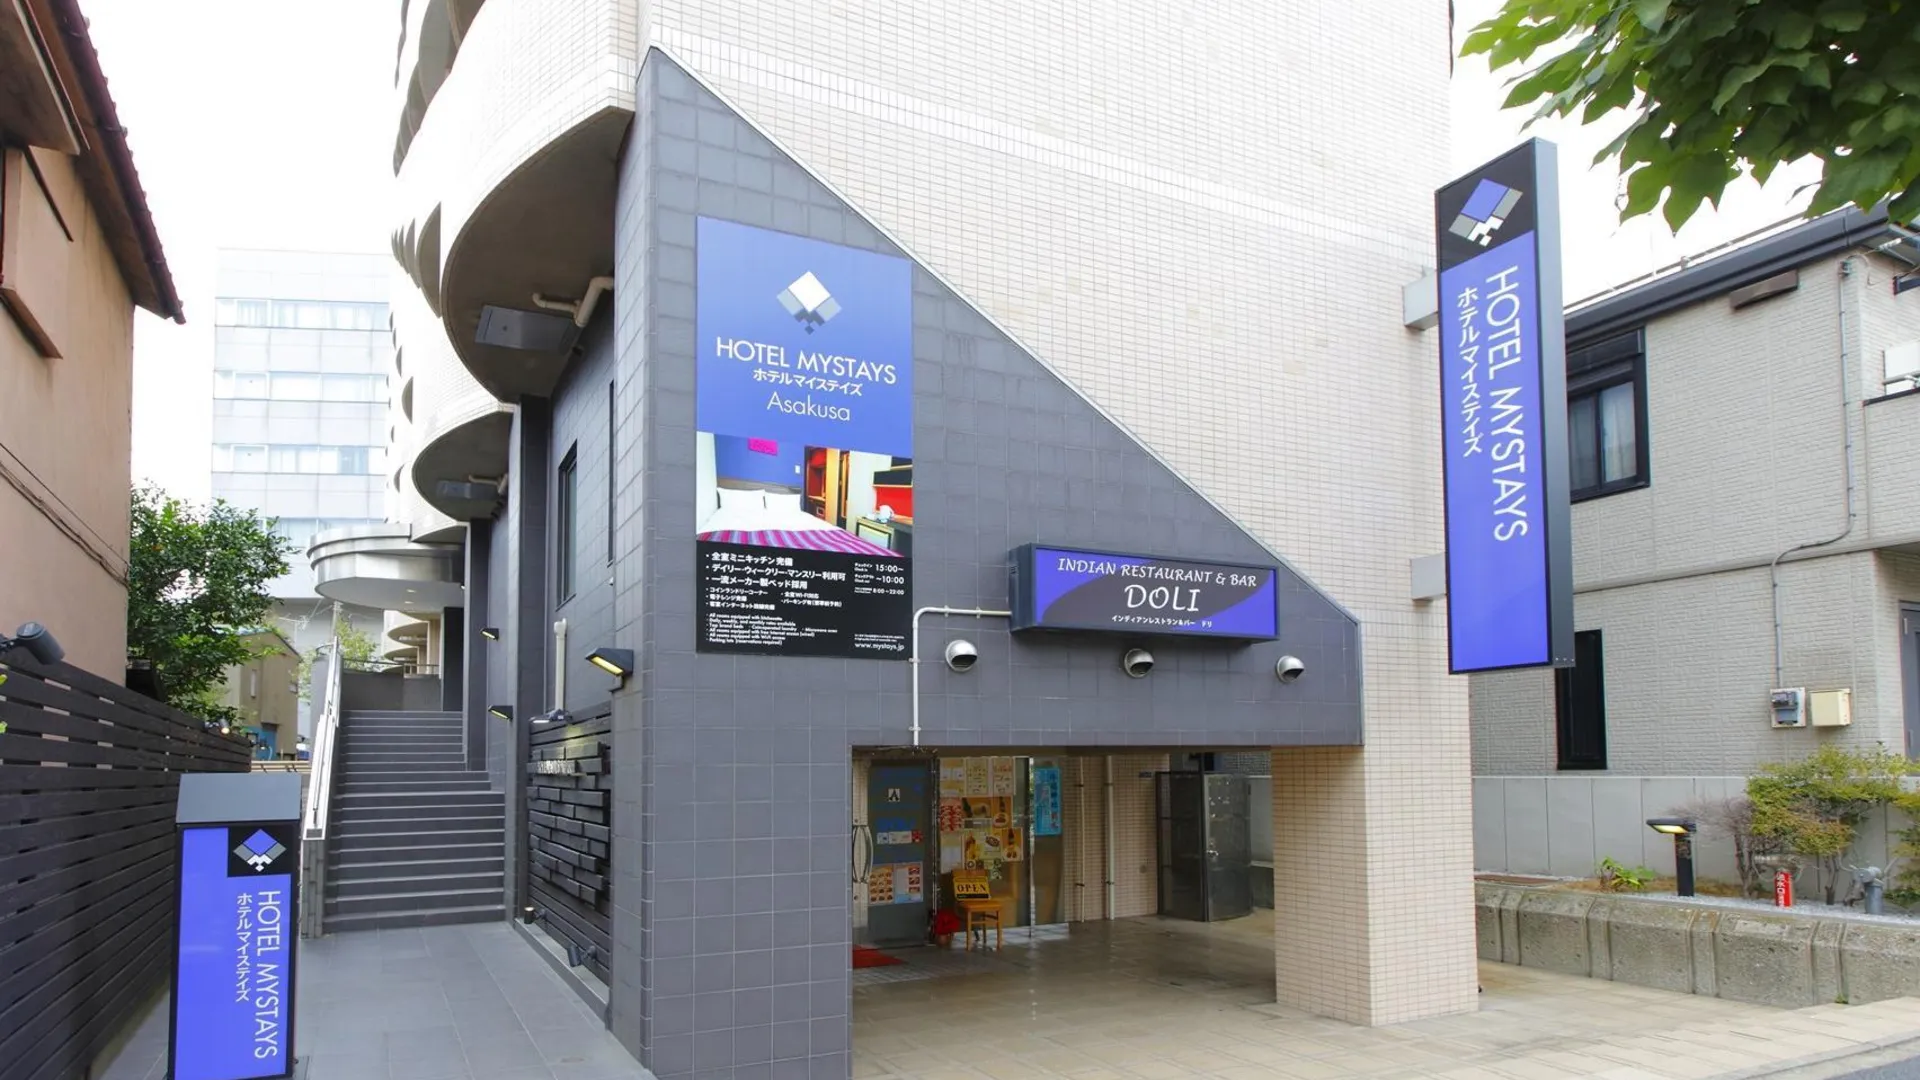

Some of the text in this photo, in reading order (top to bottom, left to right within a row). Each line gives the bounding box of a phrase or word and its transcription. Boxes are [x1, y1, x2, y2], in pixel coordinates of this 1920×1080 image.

[716, 336, 897, 385] HOTEL MYSTAYS
[1457, 287, 1483, 458] ホテルマイステイズ
[753, 368, 863, 397] ホテルマイステイズ
[766, 391, 851, 421] Asakusa
[1485, 265, 1528, 541] HOTEL MYSTAYS
[1057, 558, 1257, 587] INDIAN RESTAURANT & BAR
[1124, 584, 1201, 612] DOLI
[957, 883, 987, 893] OPEN
[236, 892, 253, 1003] ホテルマイステイズ
[254, 890, 281, 1060] HOTEL MYSTAYS
